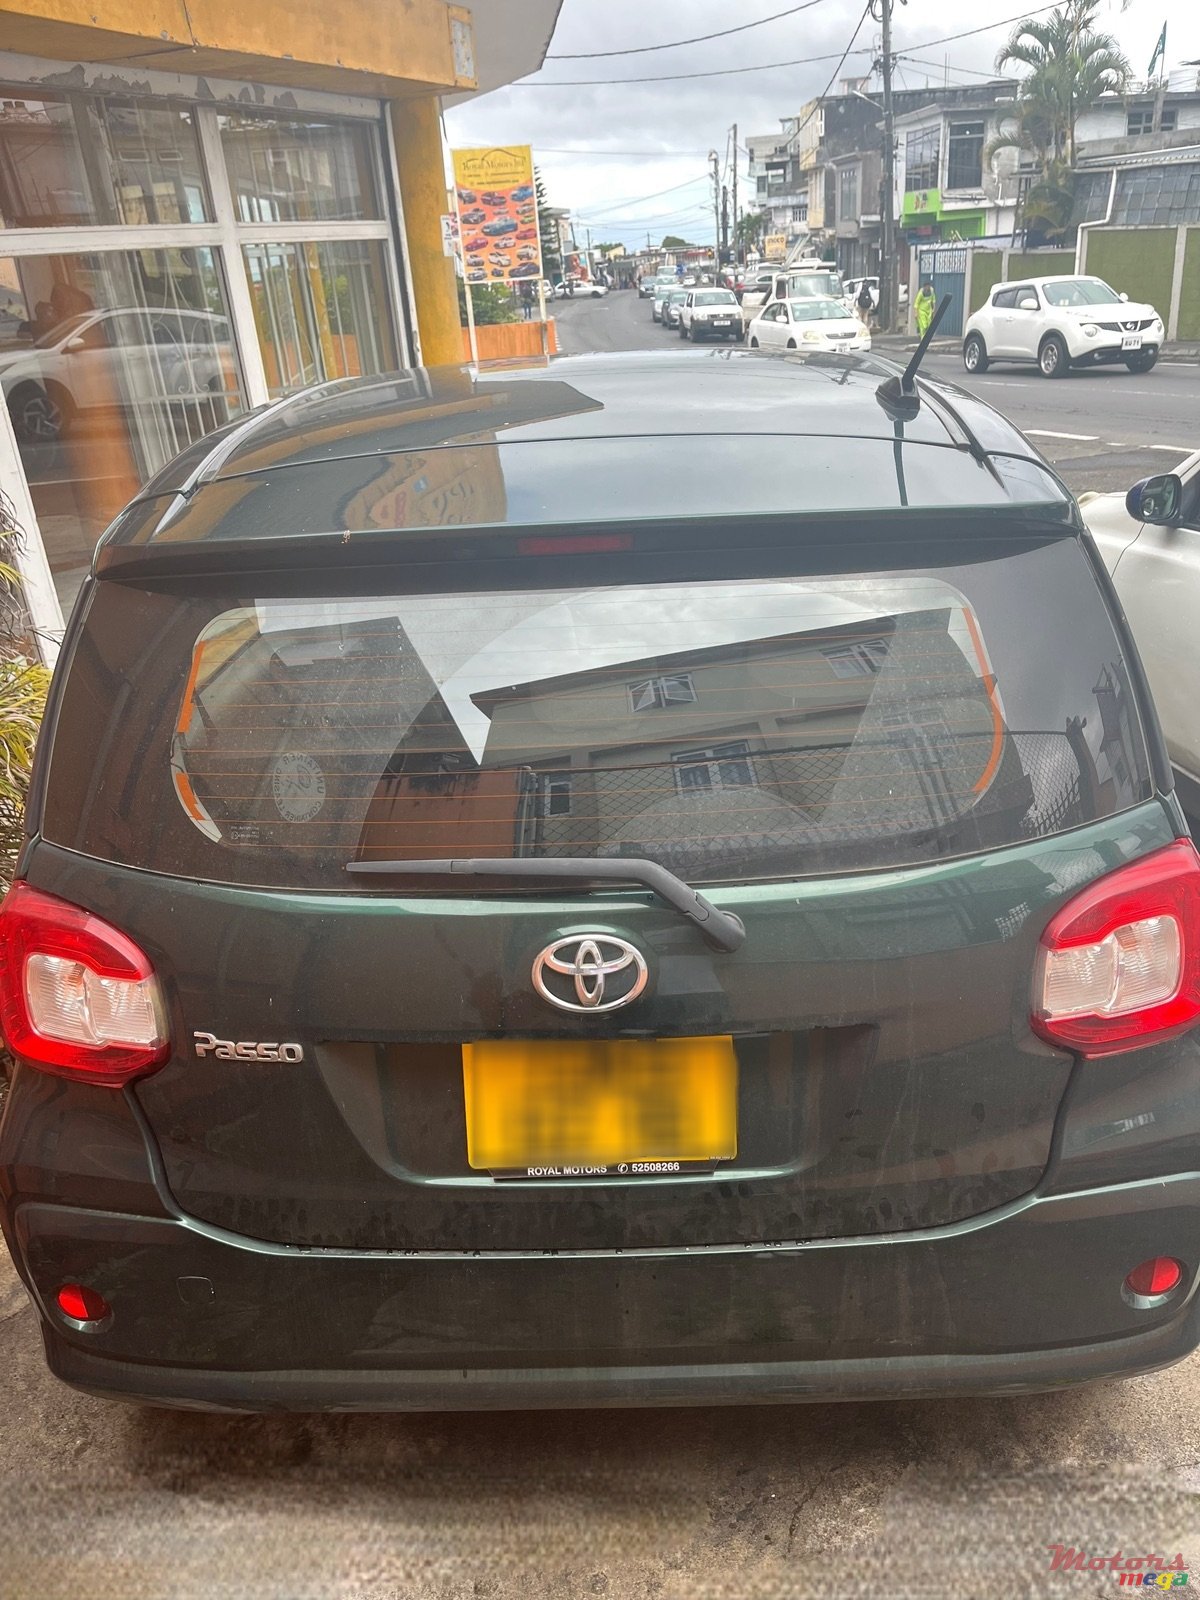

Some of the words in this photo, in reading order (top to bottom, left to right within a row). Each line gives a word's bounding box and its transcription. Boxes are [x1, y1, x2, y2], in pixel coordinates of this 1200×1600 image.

[527, 1166, 561, 1176] ROYAL
[563, 1165, 607, 1175] MOTORS
[631, 1162, 680, 1172] 52508266
